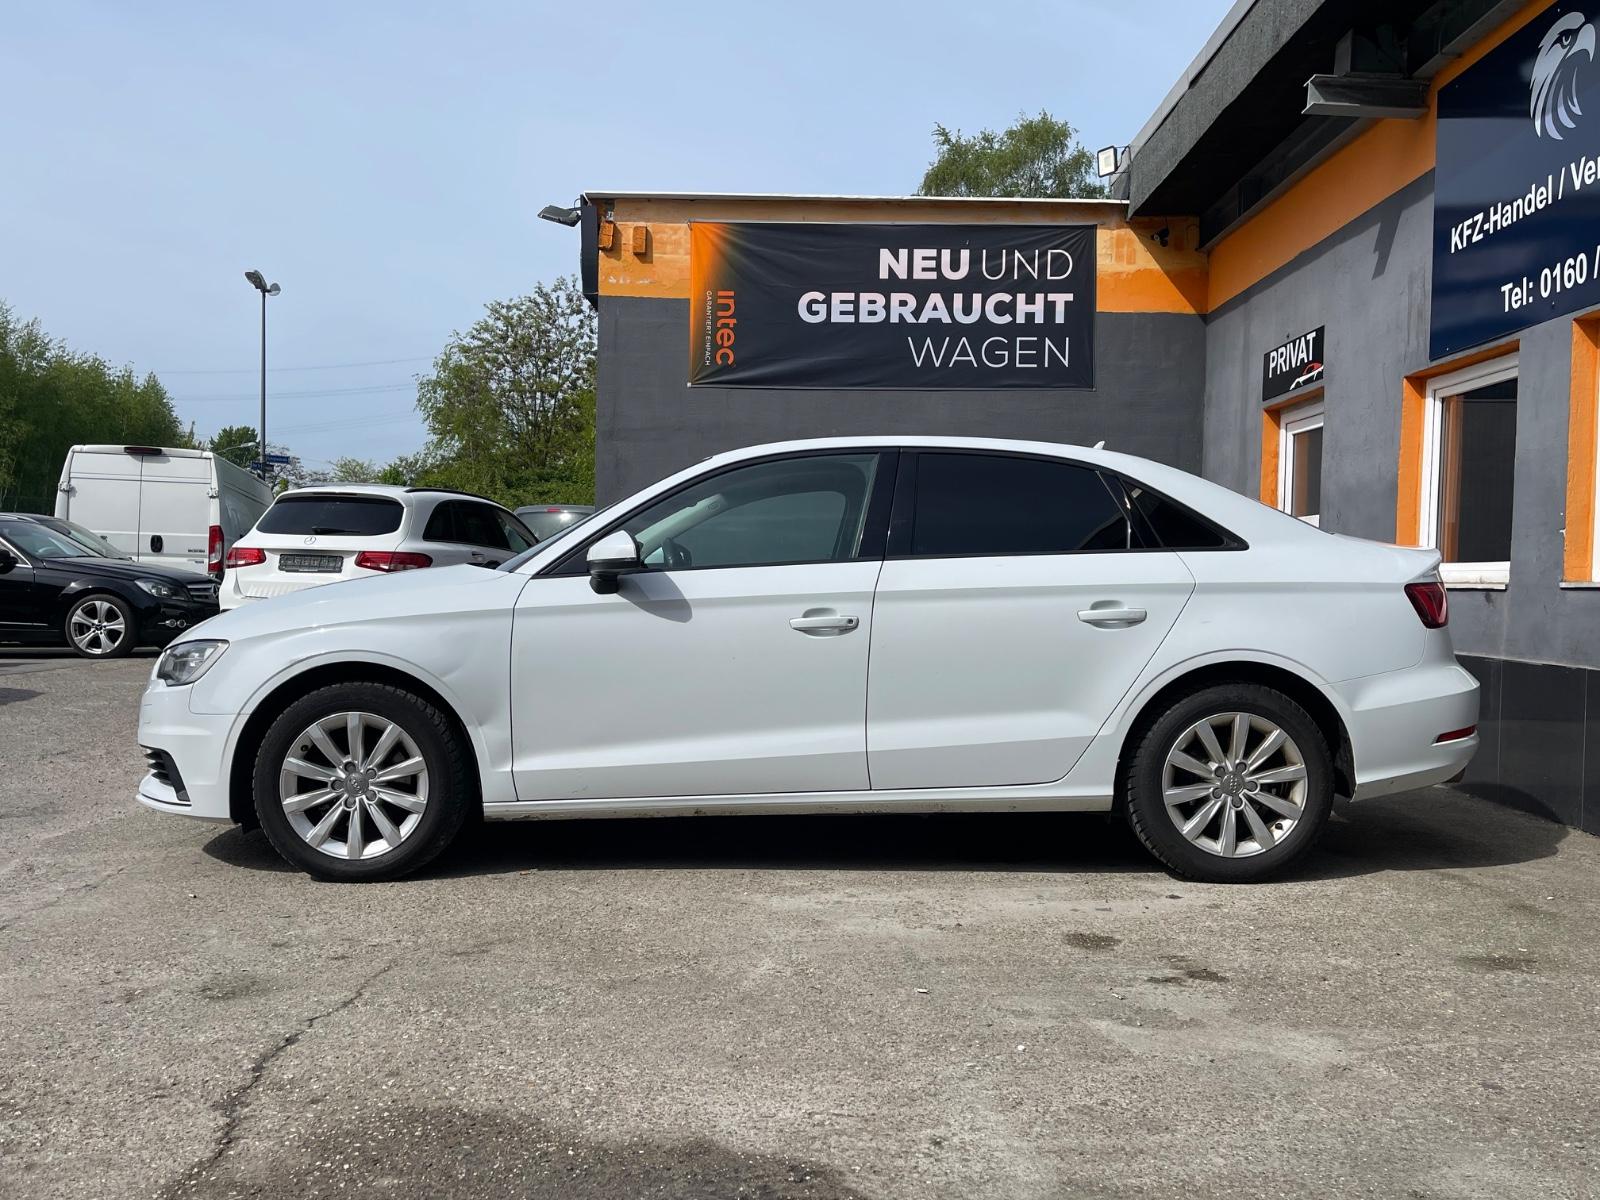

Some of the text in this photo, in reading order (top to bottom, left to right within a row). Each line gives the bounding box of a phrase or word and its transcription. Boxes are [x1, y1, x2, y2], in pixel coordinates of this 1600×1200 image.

[1451, 174, 1552, 254] KFZ-Handel
[1558, 167, 1565, 200] /
[879, 248, 1074, 281] NEU UND
[1501, 276, 1534, 313] Tel:
[1540, 252, 1588, 298] 0160
[797, 292, 1074, 324] GEBRAUCHT
[908, 336, 1070, 369] WAGEN
[1269, 331, 1317, 379] PRIVAT
